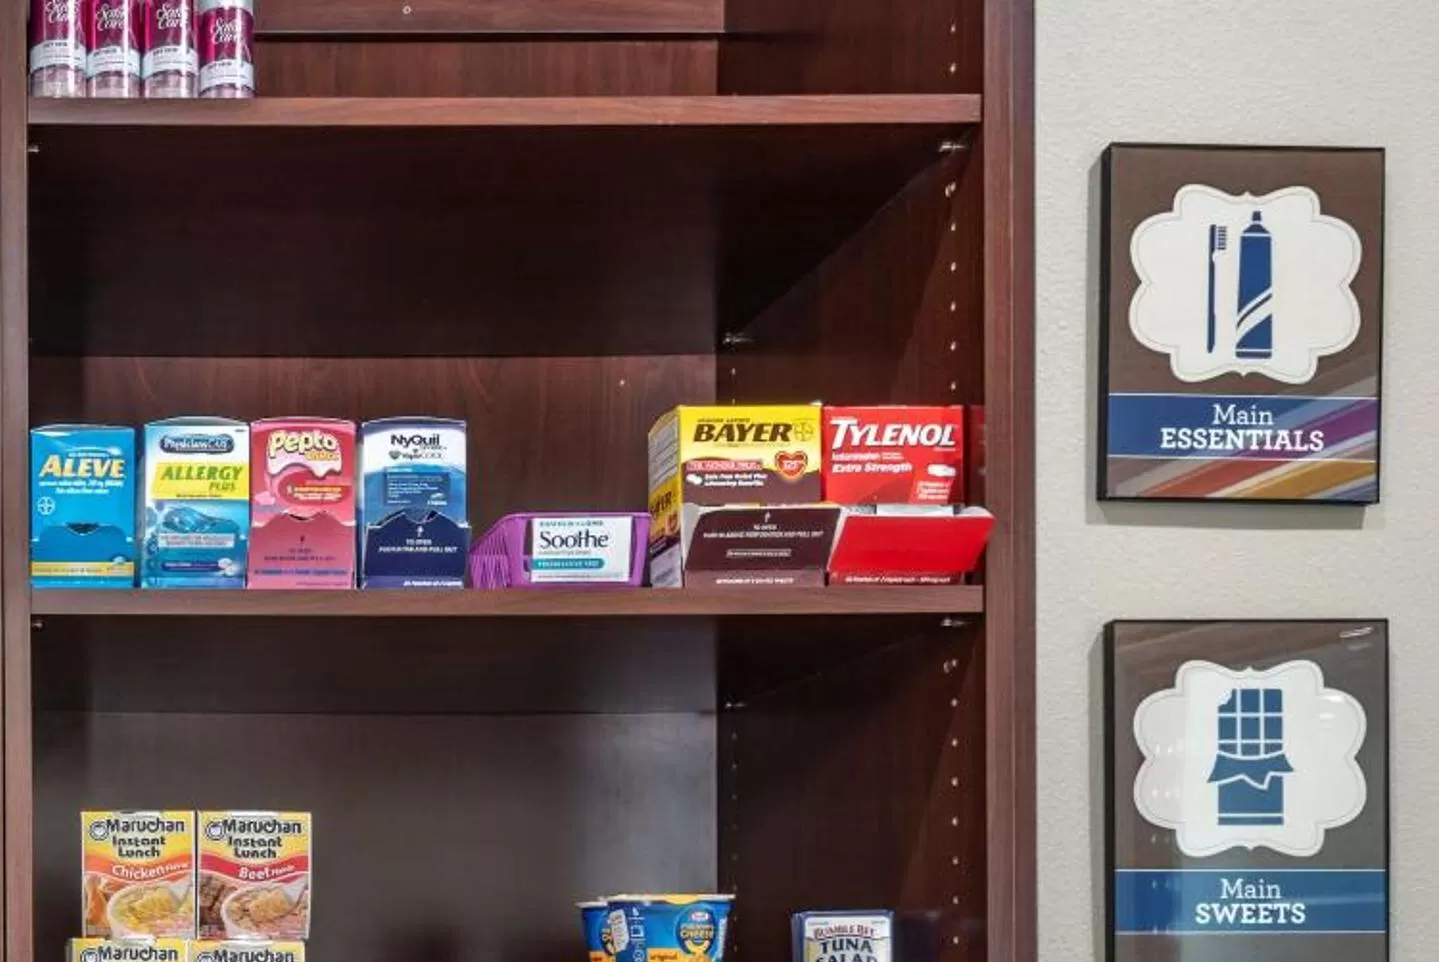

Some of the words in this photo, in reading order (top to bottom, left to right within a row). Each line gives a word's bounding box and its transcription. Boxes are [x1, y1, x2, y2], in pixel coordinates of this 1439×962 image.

[1212, 404, 1274, 426] Main
[693, 423, 793, 442] BAYER
[830, 417, 956, 450] TYLENOL
[1160, 427, 1325, 452] ESSENTIALS
[267, 429, 338, 459] Pepto
[390, 433, 440, 449] NyQuil
[38, 453, 126, 479] ALEVE
[160, 465, 244, 481] ALLERGY
[539, 528, 609, 549] Soothe
[106, 817, 185, 833] Maruchan
[222, 818, 302, 834] Maruchan
[113, 836, 166, 847] Instant
[228, 836, 283, 847] Instant
[118, 846, 160, 857] Lunch
[234, 847, 277, 858] Lunch
[111, 864, 165, 879] Chicken
[238, 865, 271, 880] Beef
[1220, 878, 1281, 900] Main
[1195, 903, 1307, 925] SWEETS
[98, 946, 179, 961] Maruchan
[820, 938, 873, 954] TUNA
